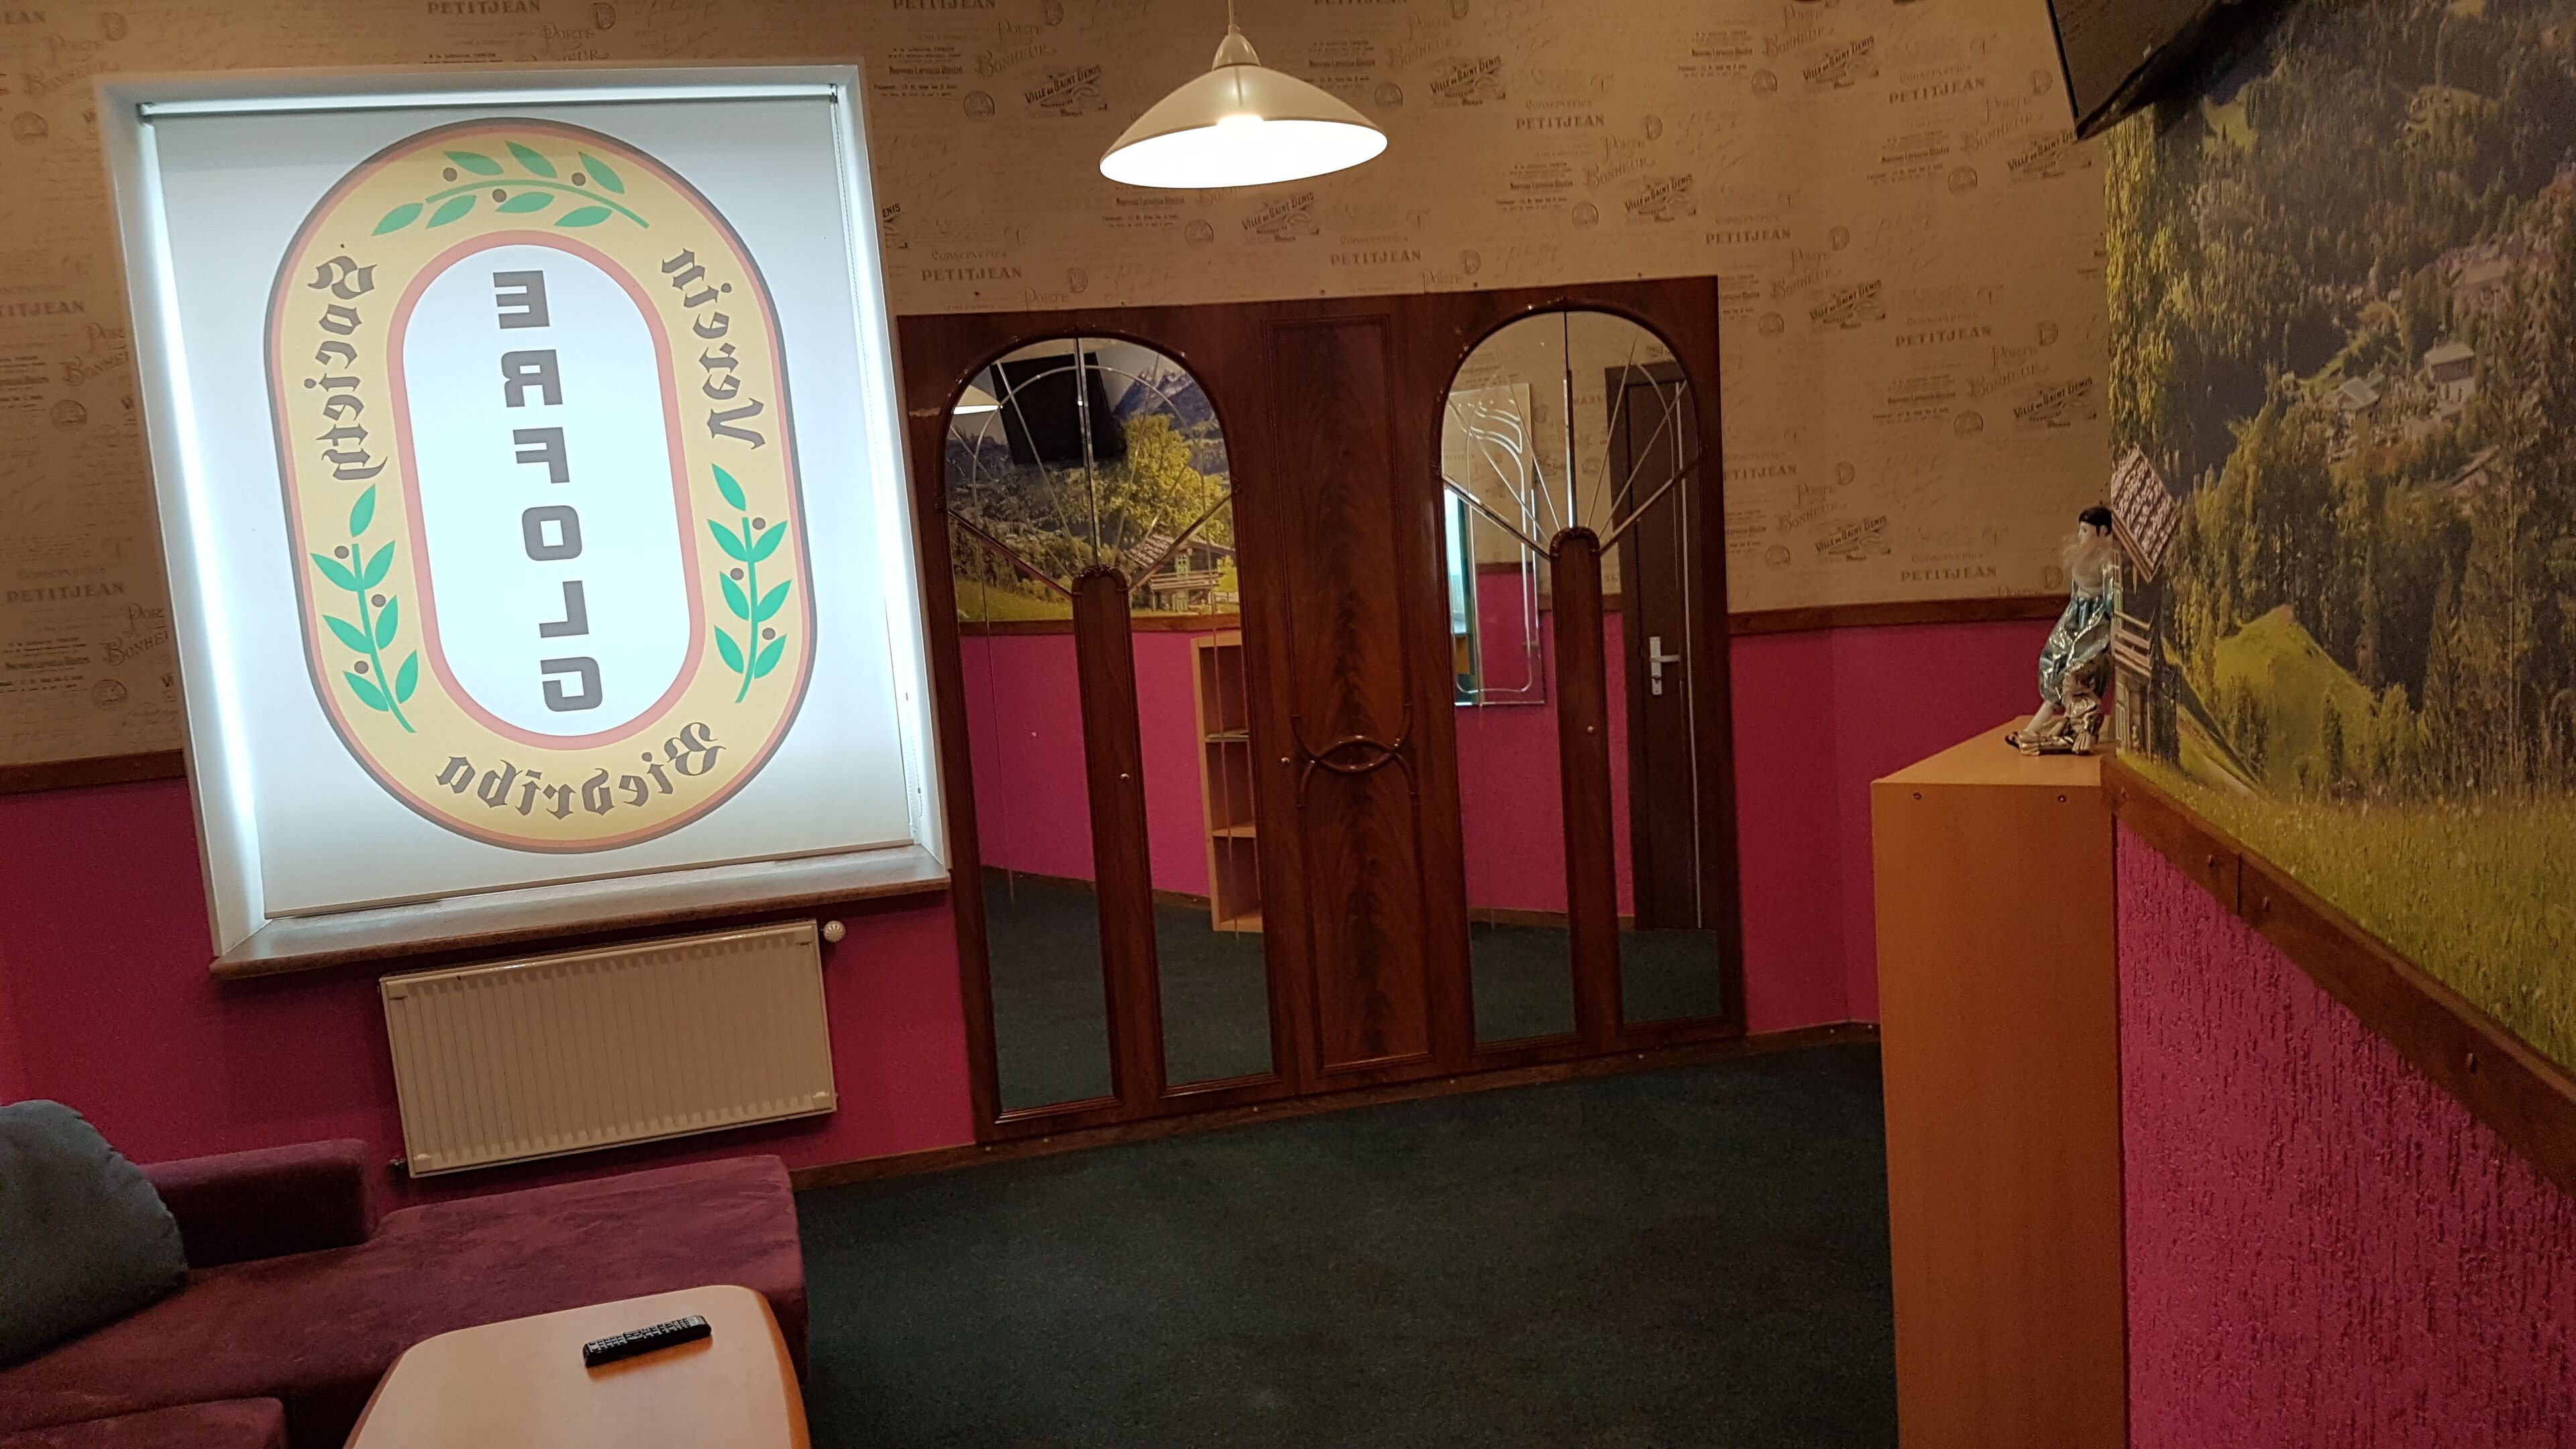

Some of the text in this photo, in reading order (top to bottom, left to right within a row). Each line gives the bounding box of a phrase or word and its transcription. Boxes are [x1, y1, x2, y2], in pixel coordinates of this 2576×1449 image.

[427, 0, 540, 14] PETITJEAN
[1888, 77, 1985, 104] PETITJEAN
[1516, 113, 1605, 129] PETITJEAN
[882, 203, 900, 218] ENIS
[1705, 227, 1791, 244] PETITJEAN
[1331, 250, 1421, 265] PETITJEAN
[922, 268, 1022, 281] PETITJEAN
[1895, 325, 1992, 347] PETITJEAN
[1900, 566, 1997, 582] PETITJEAN
[6, 582, 125, 603] PETITJEAN
